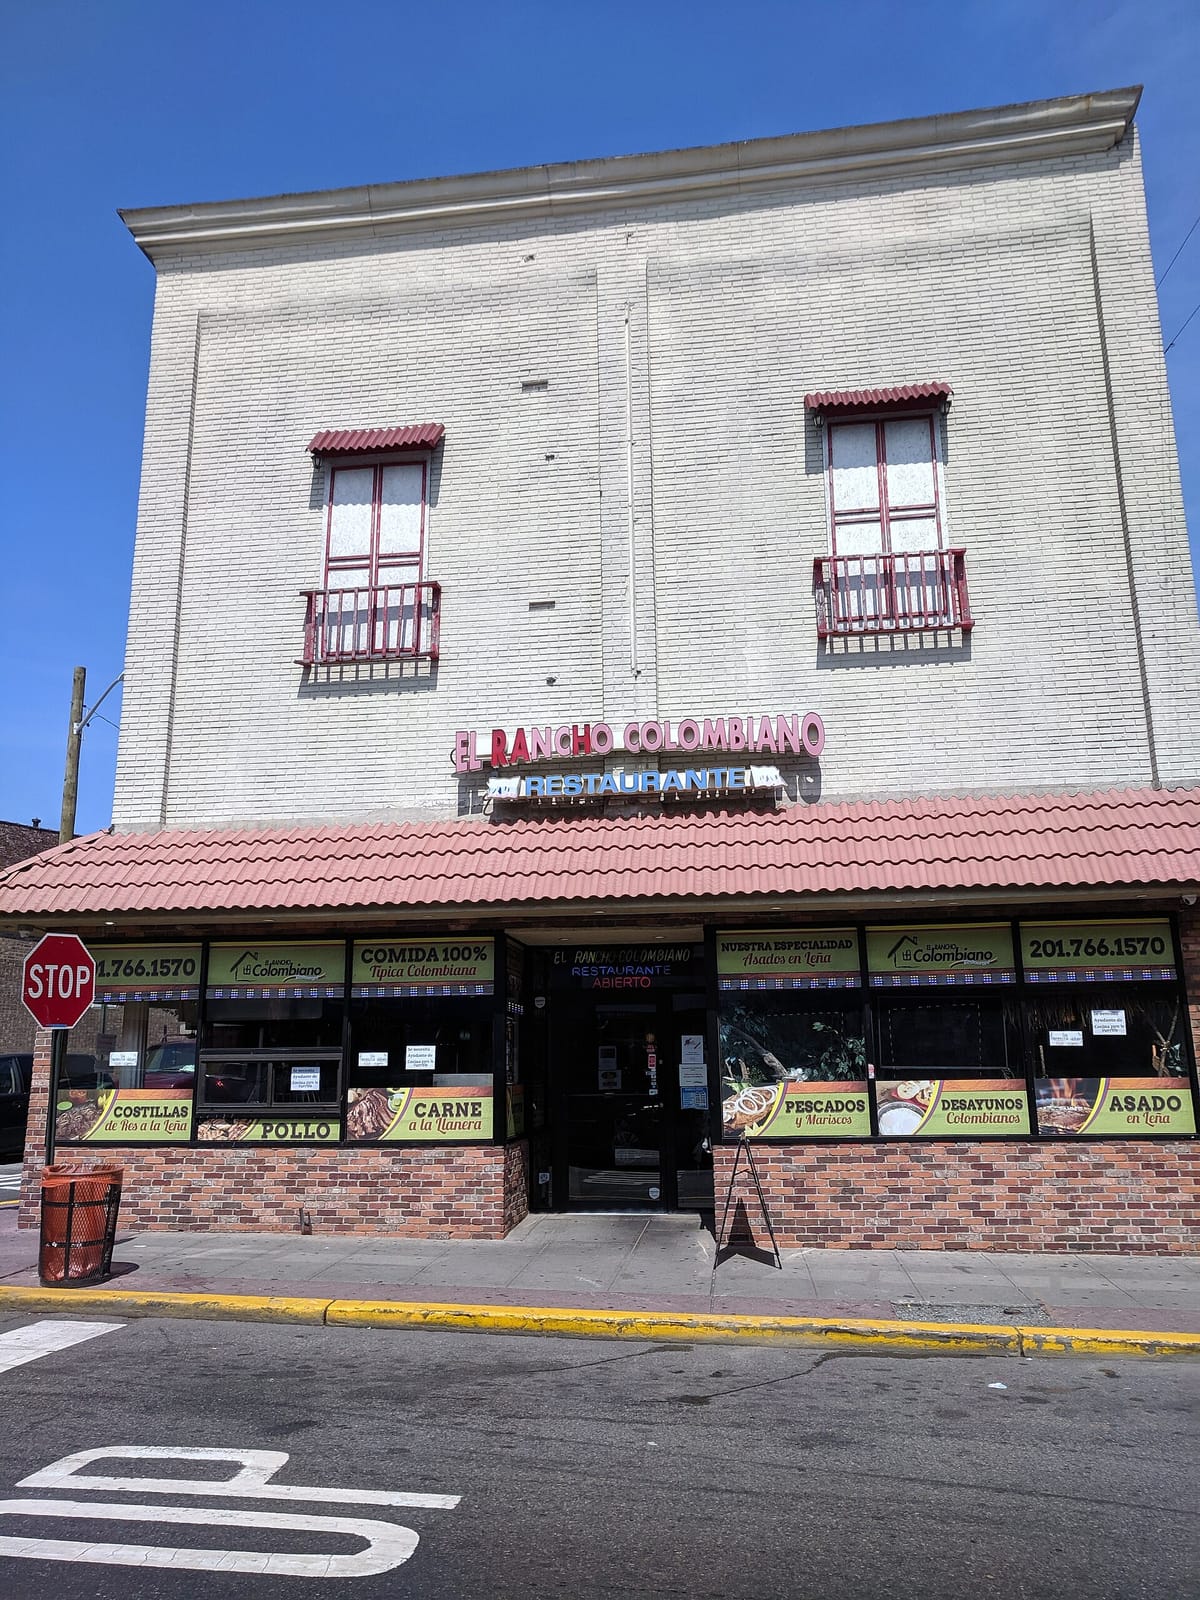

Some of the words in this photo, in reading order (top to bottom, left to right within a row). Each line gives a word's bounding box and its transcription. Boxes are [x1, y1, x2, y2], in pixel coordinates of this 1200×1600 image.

[455, 731, 482, 773] EL
[491, 723, 614, 768] RANCHO
[623, 712, 825, 759] COLOMBIANO
[524, 766, 746, 798] RESTAURANTE
[721, 942, 771, 952] NUESTRA
[774, 940, 853, 951] ESPECIALIDAD
[1030, 937, 1165, 957] 201.766.1570
[361, 947, 439, 964] COMIDA
[442, 945, 488, 962] 100%
[553, 951, 567, 964] EL
[742, 952, 785, 967] Asados
[788, 955, 801, 965] en
[805, 952, 832, 967] Leña
[914, 947, 993, 963] Colombiano
[95, 958, 196, 978] 1.766.1570
[252, 962, 323, 978] Colombiano
[407, 963, 477, 978] Colombiana
[571, 965, 672, 977] RESTAURANTE
[28, 964, 90, 999] STOP
[592, 976, 652, 989] ABIERTO
[414, 1101, 482, 1118] CARNE
[785, 1099, 865, 1113] PESCADOS
[941, 1098, 1023, 1111] DESAYUNOS
[1109, 1095, 1182, 1112] ASADO
[113, 1106, 189, 1118] COSTILLAS
[946, 1111, 1021, 1124] Colombianos
[1126, 1115, 1140, 1124] en
[1143, 1112, 1171, 1127] Leña
[105, 1119, 117, 1131] de
[121, 1119, 138, 1131] Res
[140, 1122, 147, 1131] a
[149, 1119, 161, 1131] la
[163, 1119, 187, 1134] Leña
[409, 1121, 416, 1131] a
[420, 1119, 432, 1131] la
[435, 1118, 482, 1134] Llanera
[795, 1115, 802, 1128] y
[805, 1114, 853, 1125] Mariscos
[261, 1122, 331, 1139] POLLO
